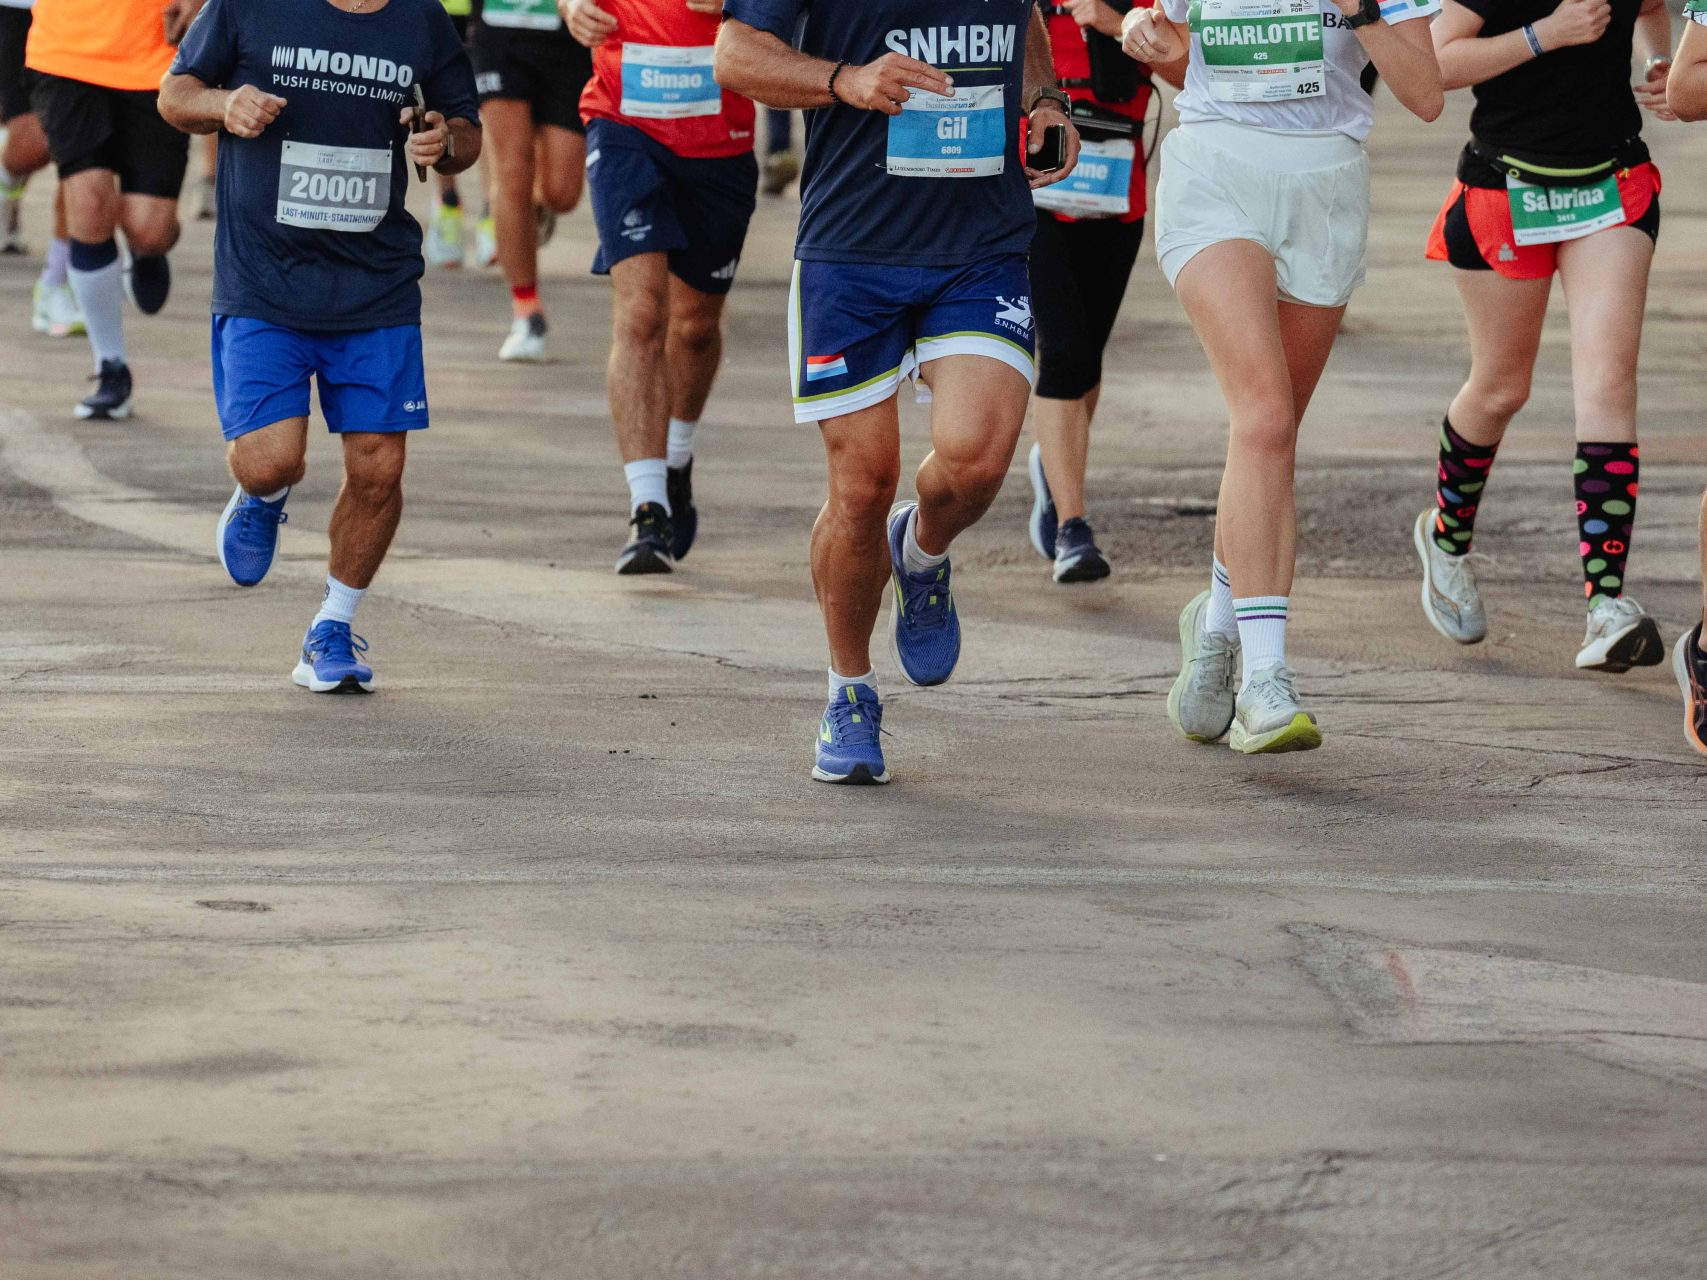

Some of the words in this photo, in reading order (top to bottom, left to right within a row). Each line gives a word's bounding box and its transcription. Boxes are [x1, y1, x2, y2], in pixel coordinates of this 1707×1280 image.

[884, 24, 1016, 65] SNHBM
[1202, 21, 1320, 46] CHARLOTTE
[295, 46, 413, 88] MONDO
[1253, 52, 1268, 60] 425
[272, 73, 309, 89] PUSH
[311, 78, 367, 97] BEYOND
[369, 86, 406, 105] LIMITS
[640, 67, 703, 89] Simao
[1296, 81, 1320, 94] 425
[937, 116, 968, 140] Gil
[941, 145, 962, 155] 6809
[290, 171, 377, 205] 20001
[1522, 187, 1605, 213] Sabrina
[282, 207, 383, 224] LAST-MINUTE-STARTNUMMER
